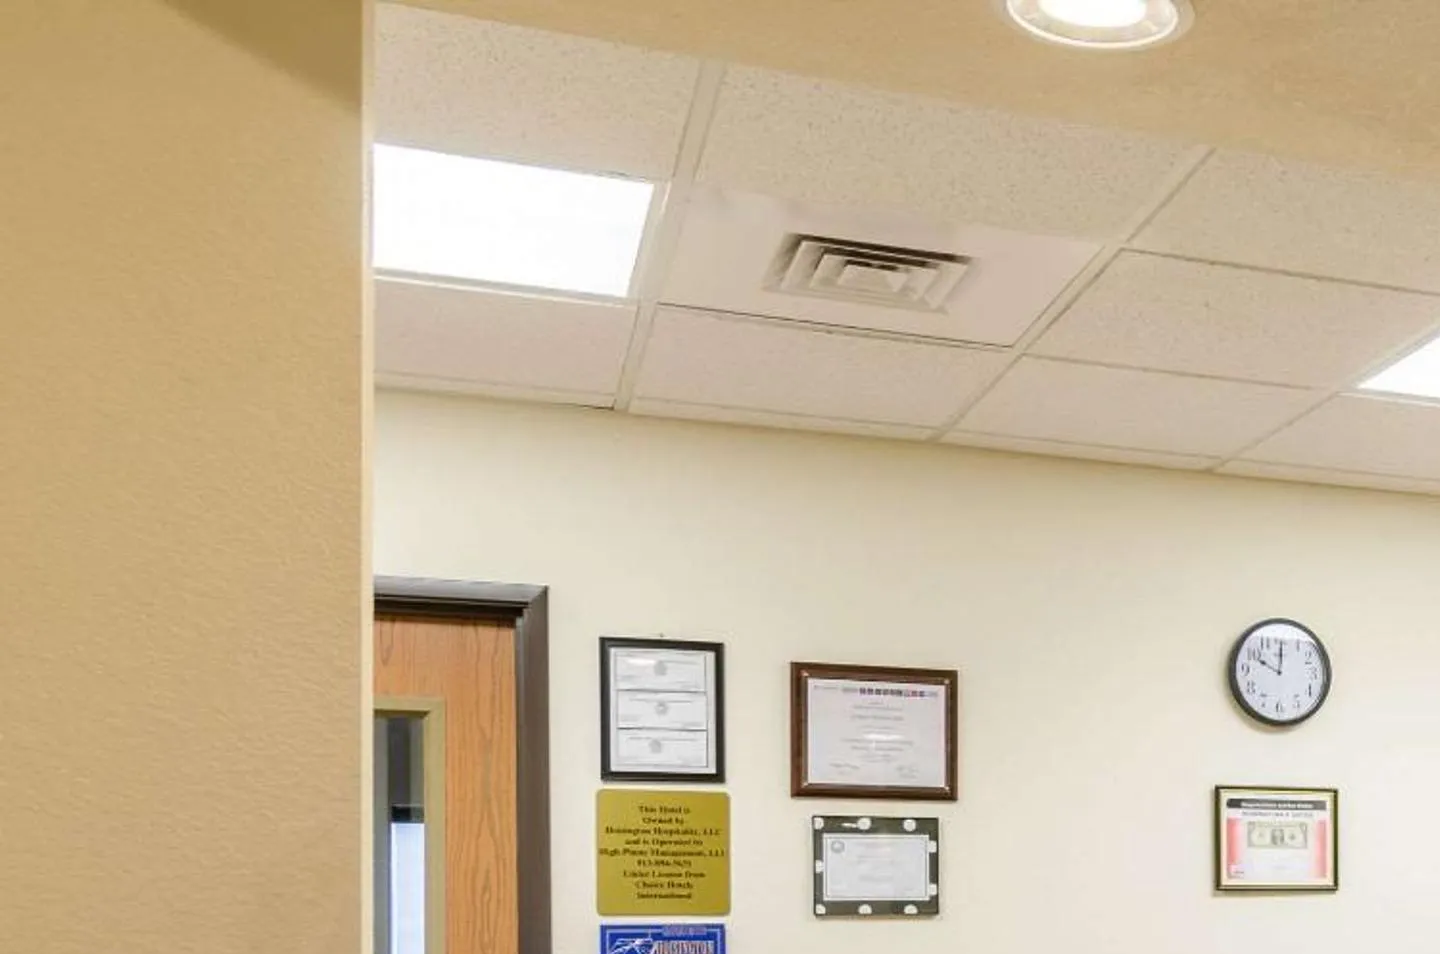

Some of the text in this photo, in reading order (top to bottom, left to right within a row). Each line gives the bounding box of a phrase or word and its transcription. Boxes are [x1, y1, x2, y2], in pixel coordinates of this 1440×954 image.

[1260, 634, 1270, 650] 11
[1304, 649, 1313, 665] 2
[1241, 663, 1251, 677] 9
[1246, 679, 1256, 695] 8
[1275, 699, 1286, 713] 6
[659, 805, 682, 814] Hotel
[642, 816, 685, 826] Owned by
[624, 838, 640, 846] and
